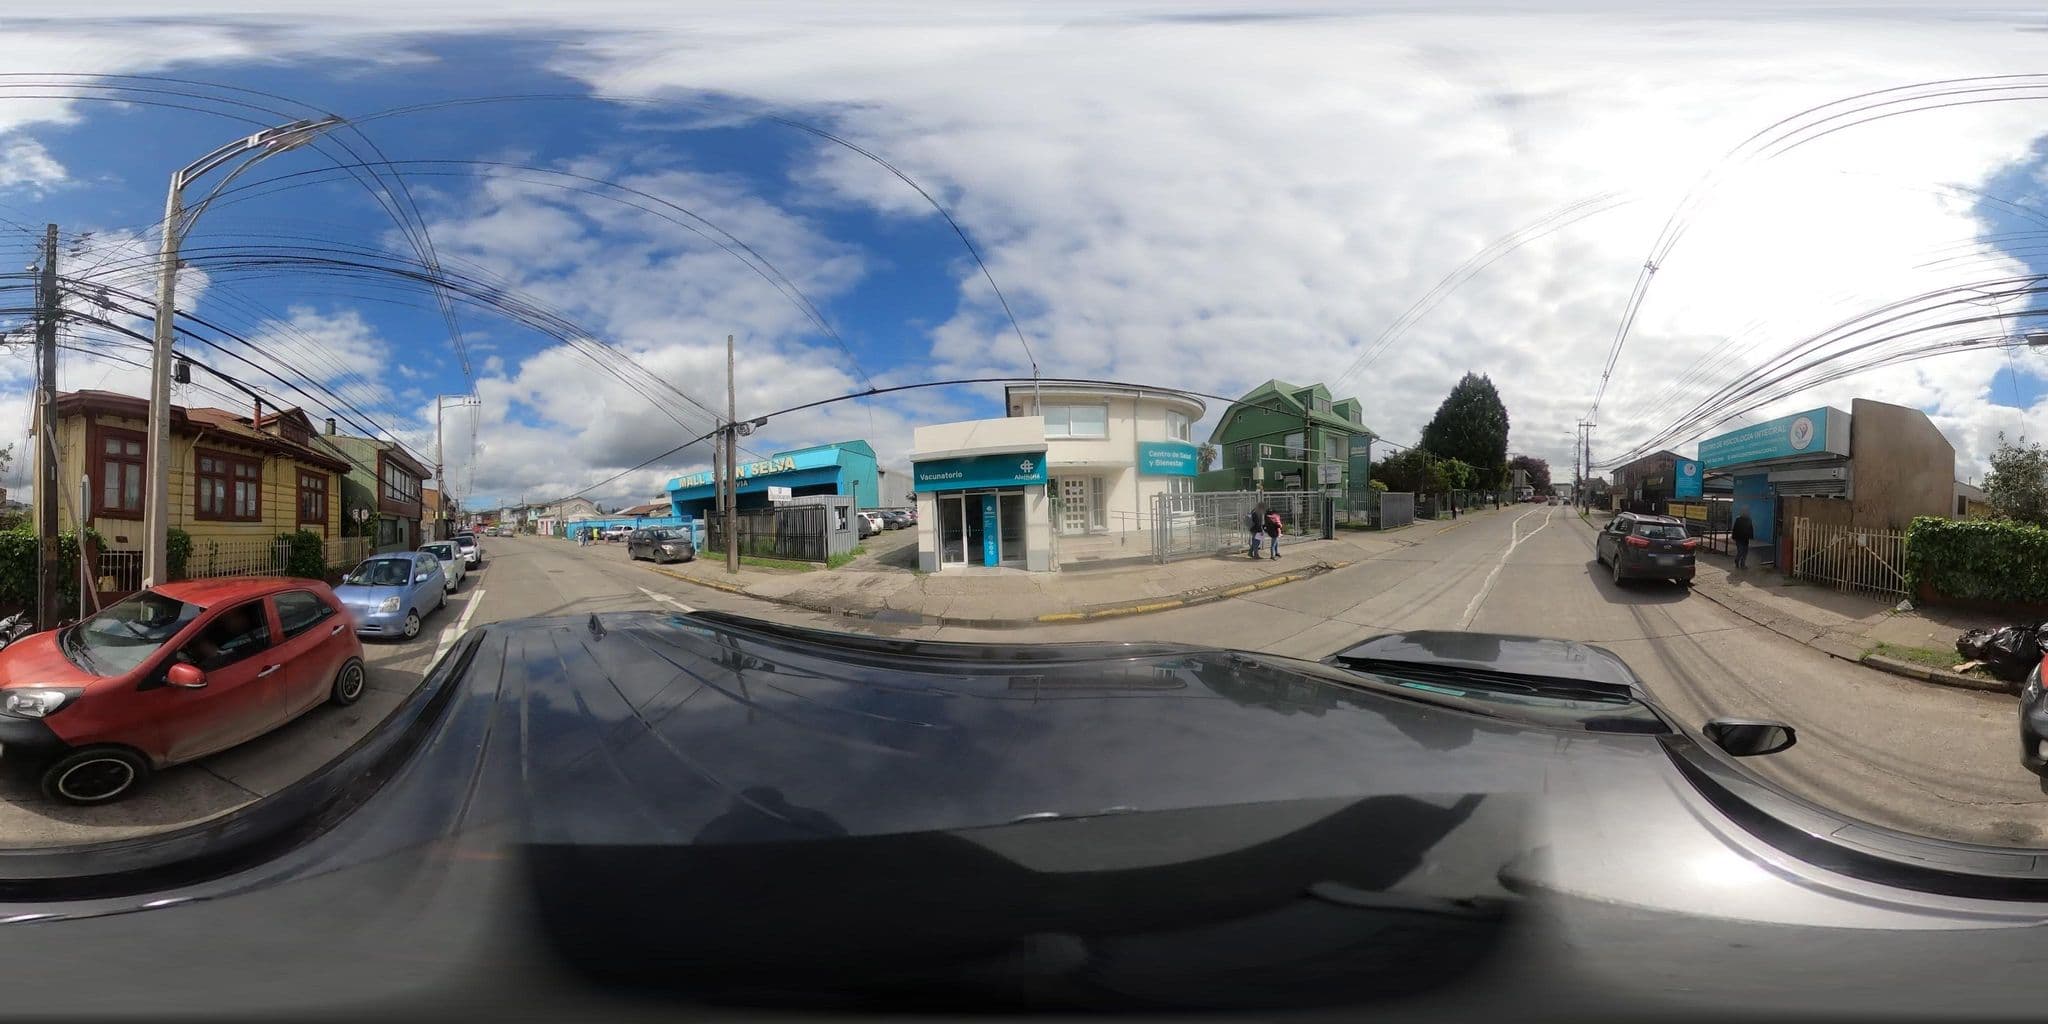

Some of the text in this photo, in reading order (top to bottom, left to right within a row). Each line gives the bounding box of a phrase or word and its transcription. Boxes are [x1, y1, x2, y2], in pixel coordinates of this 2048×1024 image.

[680, 474, 705, 488] MALL
[751, 455, 796, 475] SELVA
[920, 471, 963, 480] Vacunatorio
